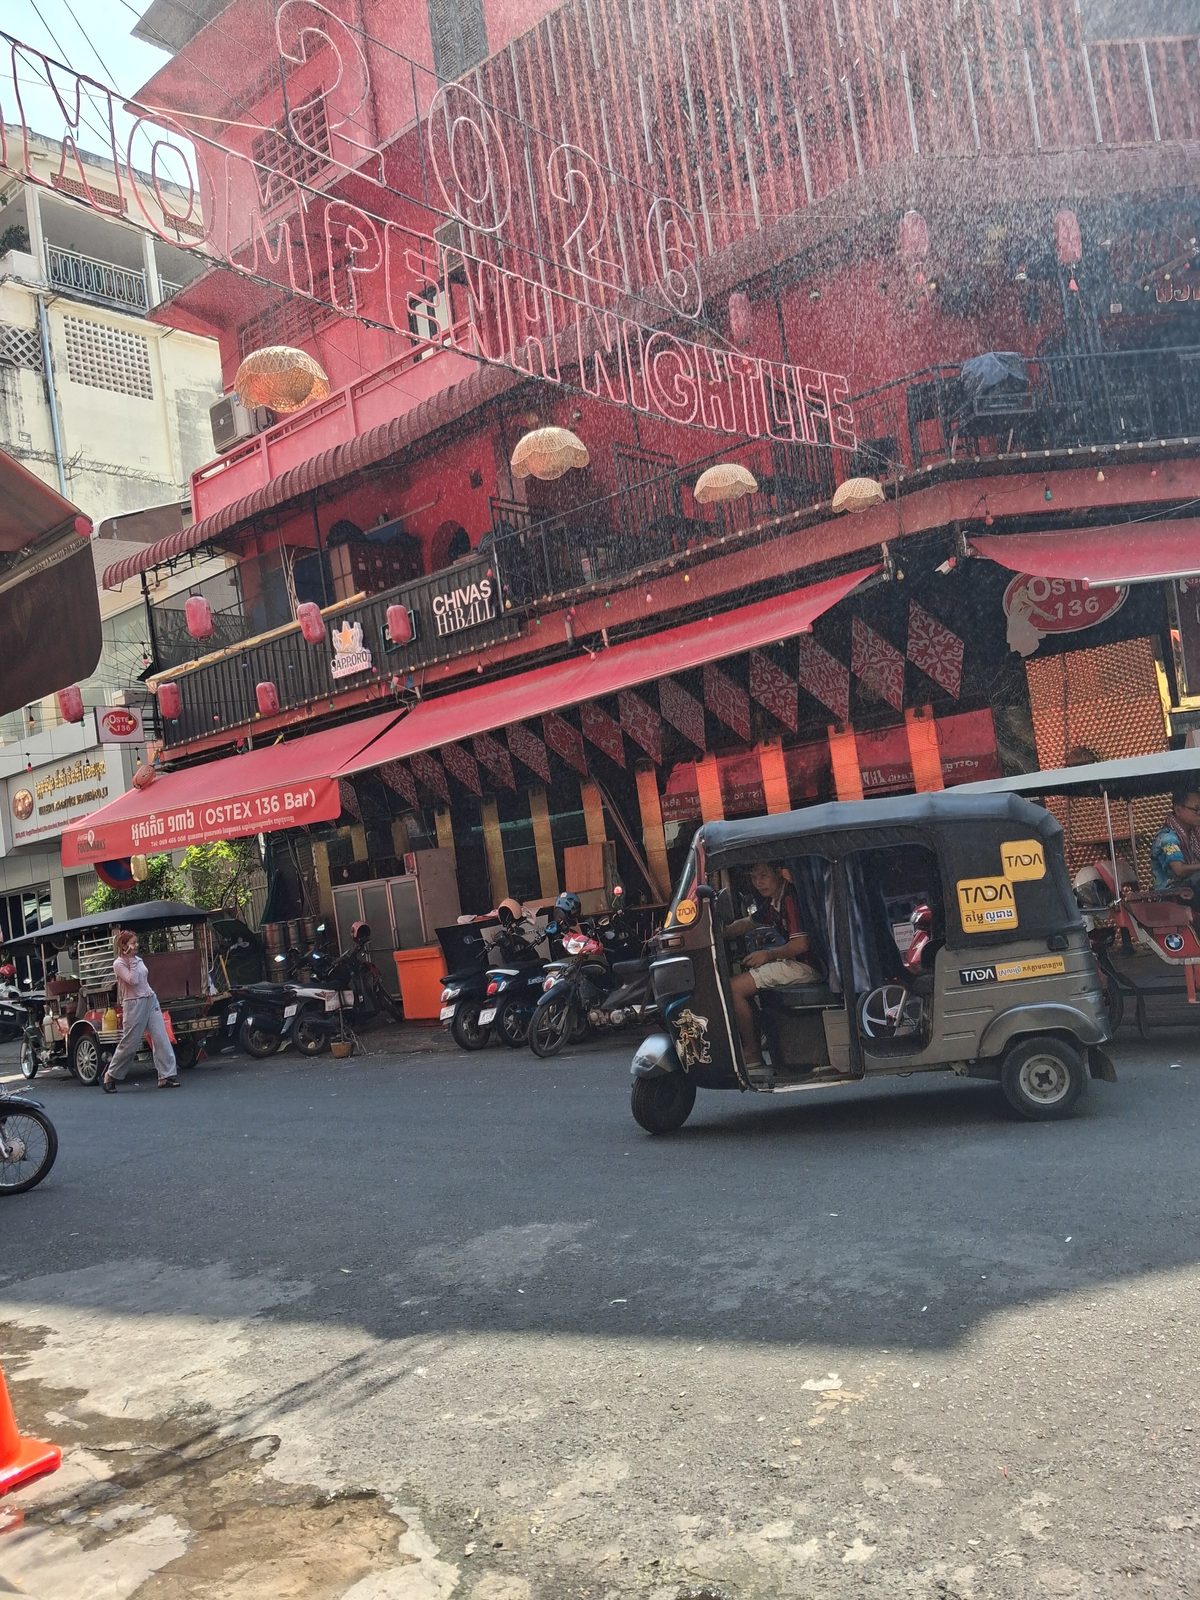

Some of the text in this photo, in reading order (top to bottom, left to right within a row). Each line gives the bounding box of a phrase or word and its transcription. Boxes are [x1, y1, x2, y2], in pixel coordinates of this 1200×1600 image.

[0, 41, 857, 450] NOM PENH NIGHTLIFE
[433, 579, 491, 614] CHIVAS
[1027, 577, 1121, 602] OST
[435, 598, 496, 637] HiBALL
[1055, 597, 1099, 619] 136
[331, 651, 368, 672] SAPPORO
[109, 714, 133, 724] OSTE
[255, 796, 281, 816] 136
[284, 788, 316, 810] Bar)
[1005, 853, 1043, 868] TADA
[960, 884, 1013, 904] TADA
[678, 907, 696, 917] TADA
[962, 968, 995, 983] TADA
